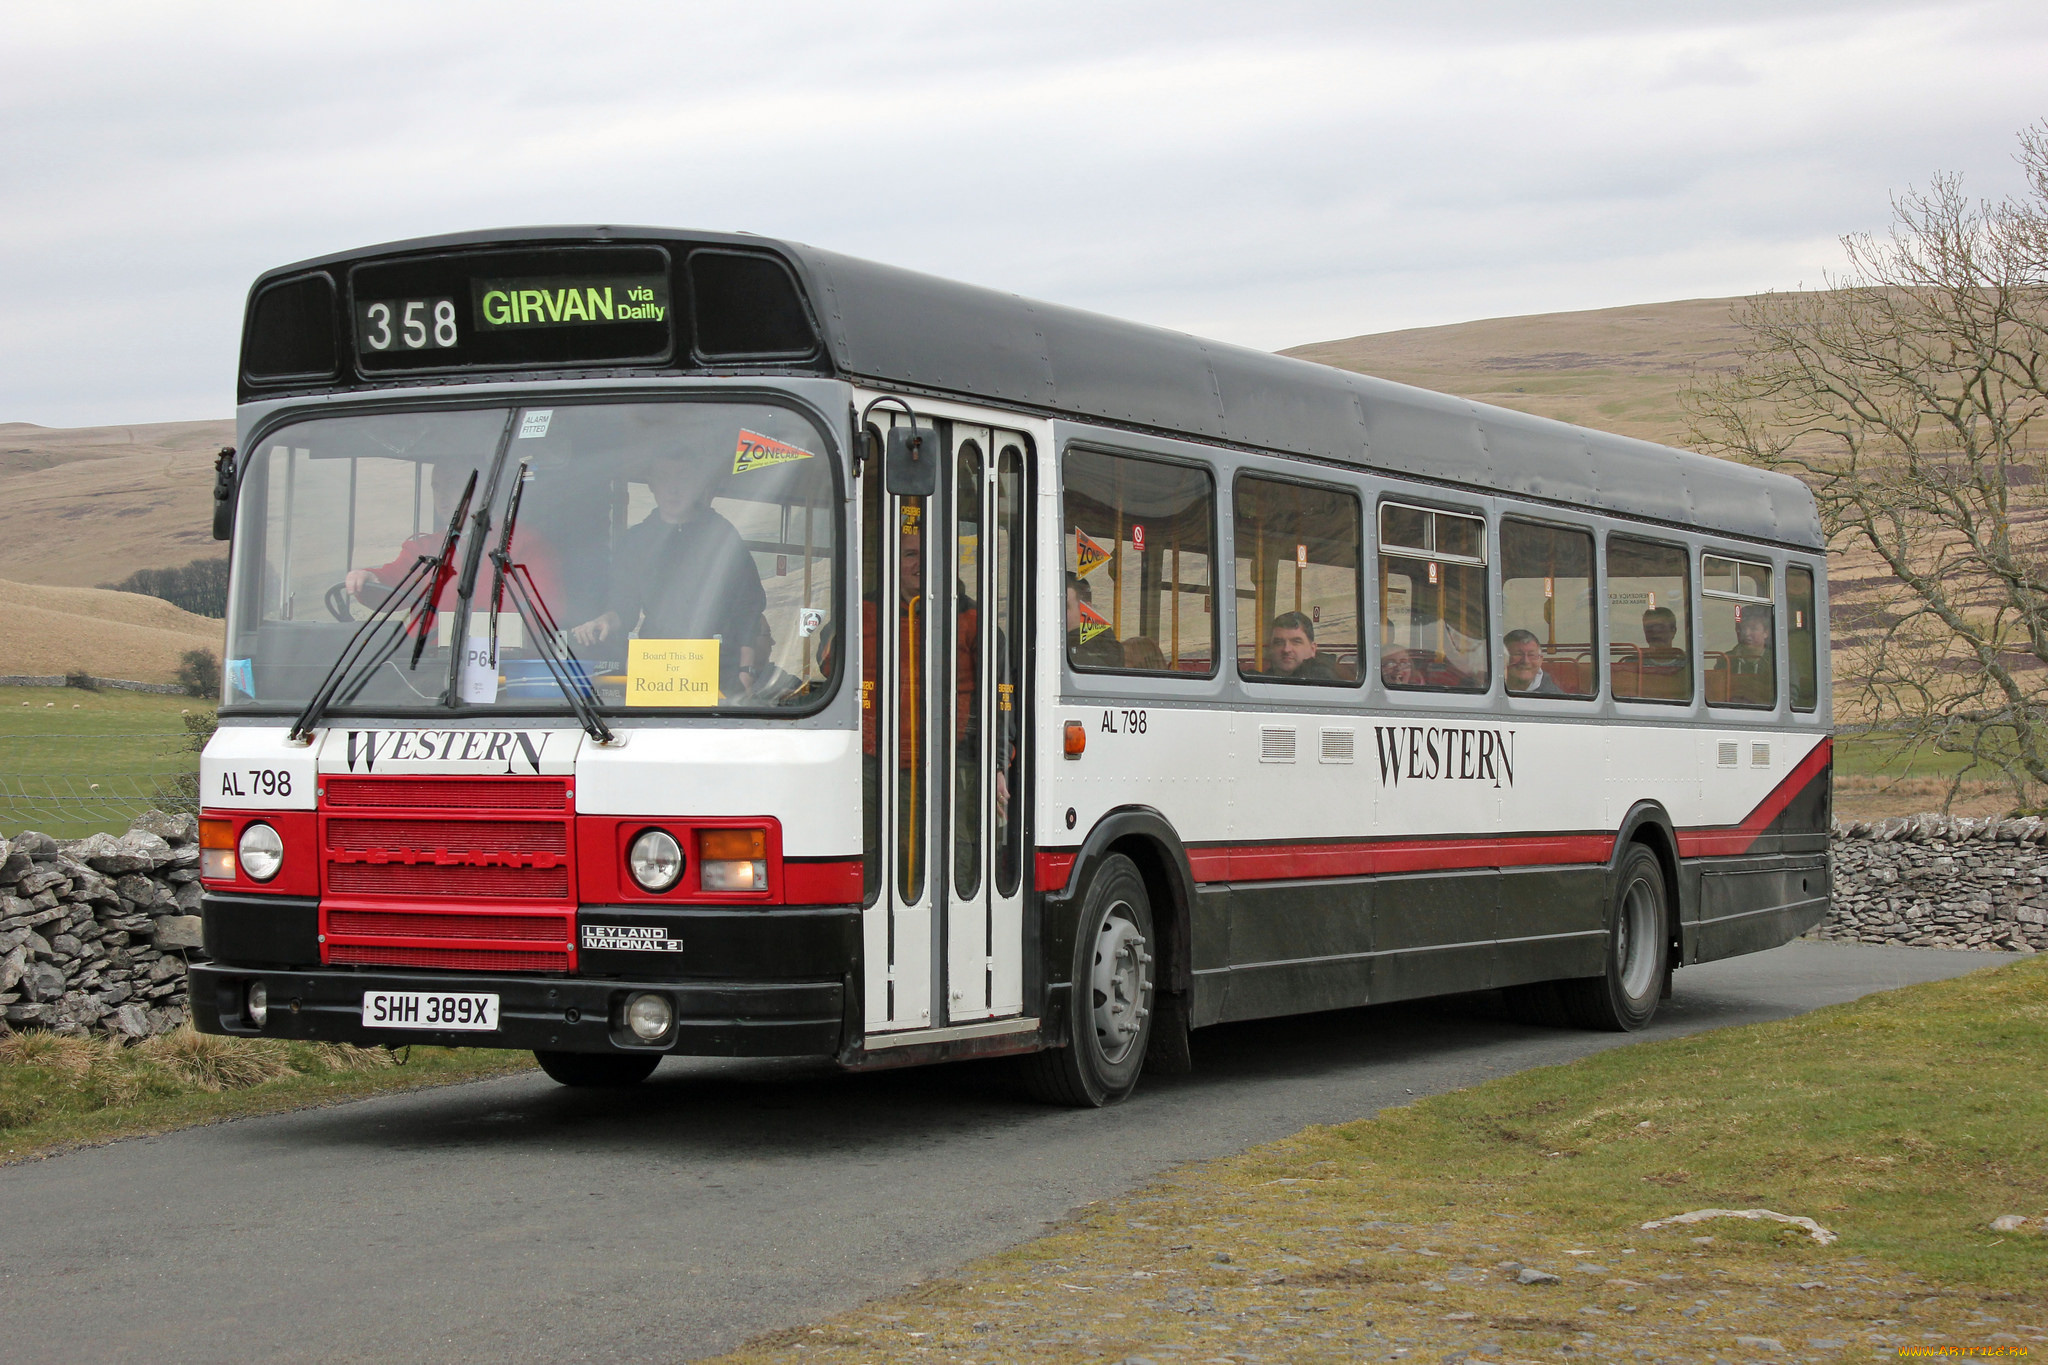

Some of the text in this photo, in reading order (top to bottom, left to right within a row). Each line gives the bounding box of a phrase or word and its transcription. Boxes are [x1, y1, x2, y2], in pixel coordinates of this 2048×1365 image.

[627, 286, 654, 301] via
[482, 287, 615, 325] GIRVAN
[617, 303, 666, 322] Dailly
[367, 300, 458, 350] 358
[522, 425, 546, 433] FITTED
[525, 415, 549, 424] ALARM
[736, 440, 800, 463] ZONECARD
[642, 651, 704, 660] Board This Bus
[666, 663, 680, 672] For
[635, 677, 709, 692] Road Run
[1101, 709, 1147, 734] AL 798
[346, 731, 554, 775] WESTERN
[1374, 726, 1516, 788] WESTERN
[221, 769, 292, 797] AL 798
[334, 846, 558, 870] LEYLAND
[586, 927, 664, 938] LEYLAND
[586, 938, 678, 950] NATIONAL 2
[373, 995, 489, 1024] SHH 389X
